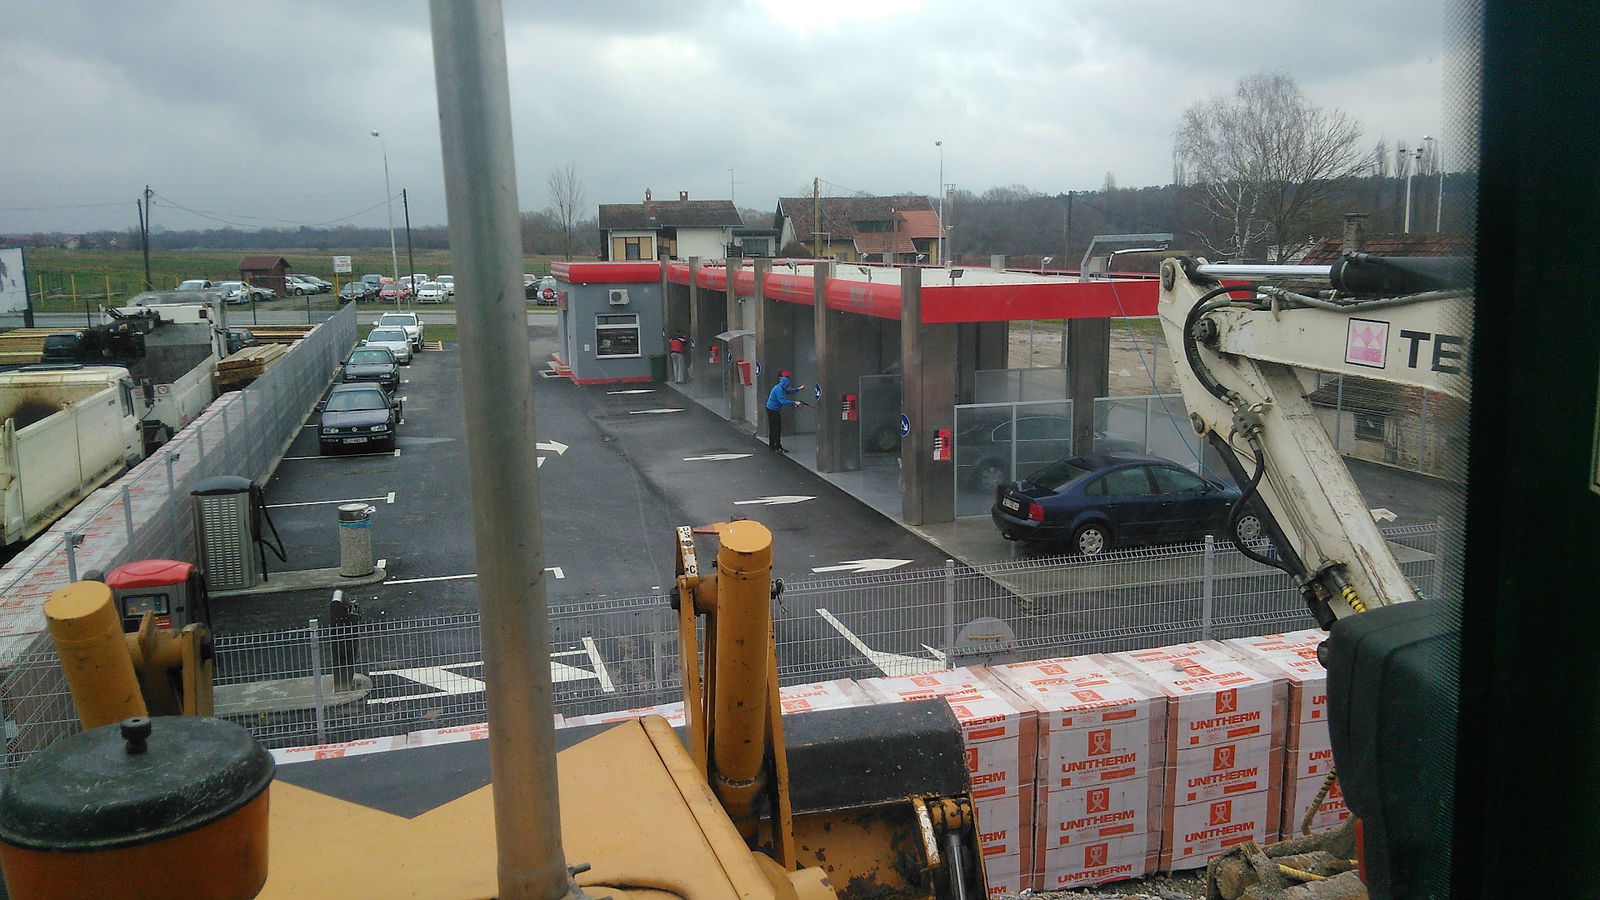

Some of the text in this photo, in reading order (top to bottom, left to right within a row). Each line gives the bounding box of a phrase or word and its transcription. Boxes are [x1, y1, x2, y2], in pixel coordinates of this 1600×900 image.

[1175, 672, 1245, 686] UNITHERM
[1060, 697, 1136, 712] UNITHERM
[1190, 711, 1260, 731] UNITHERM
[1061, 752, 1136, 773] UNITHERM
[1187, 767, 1258, 788] UNITHERM
[1059, 809, 1135, 831] UNITHERM
[1185, 821, 1255, 843] UNITHERM
[1057, 863, 1132, 884] UNITHERM
